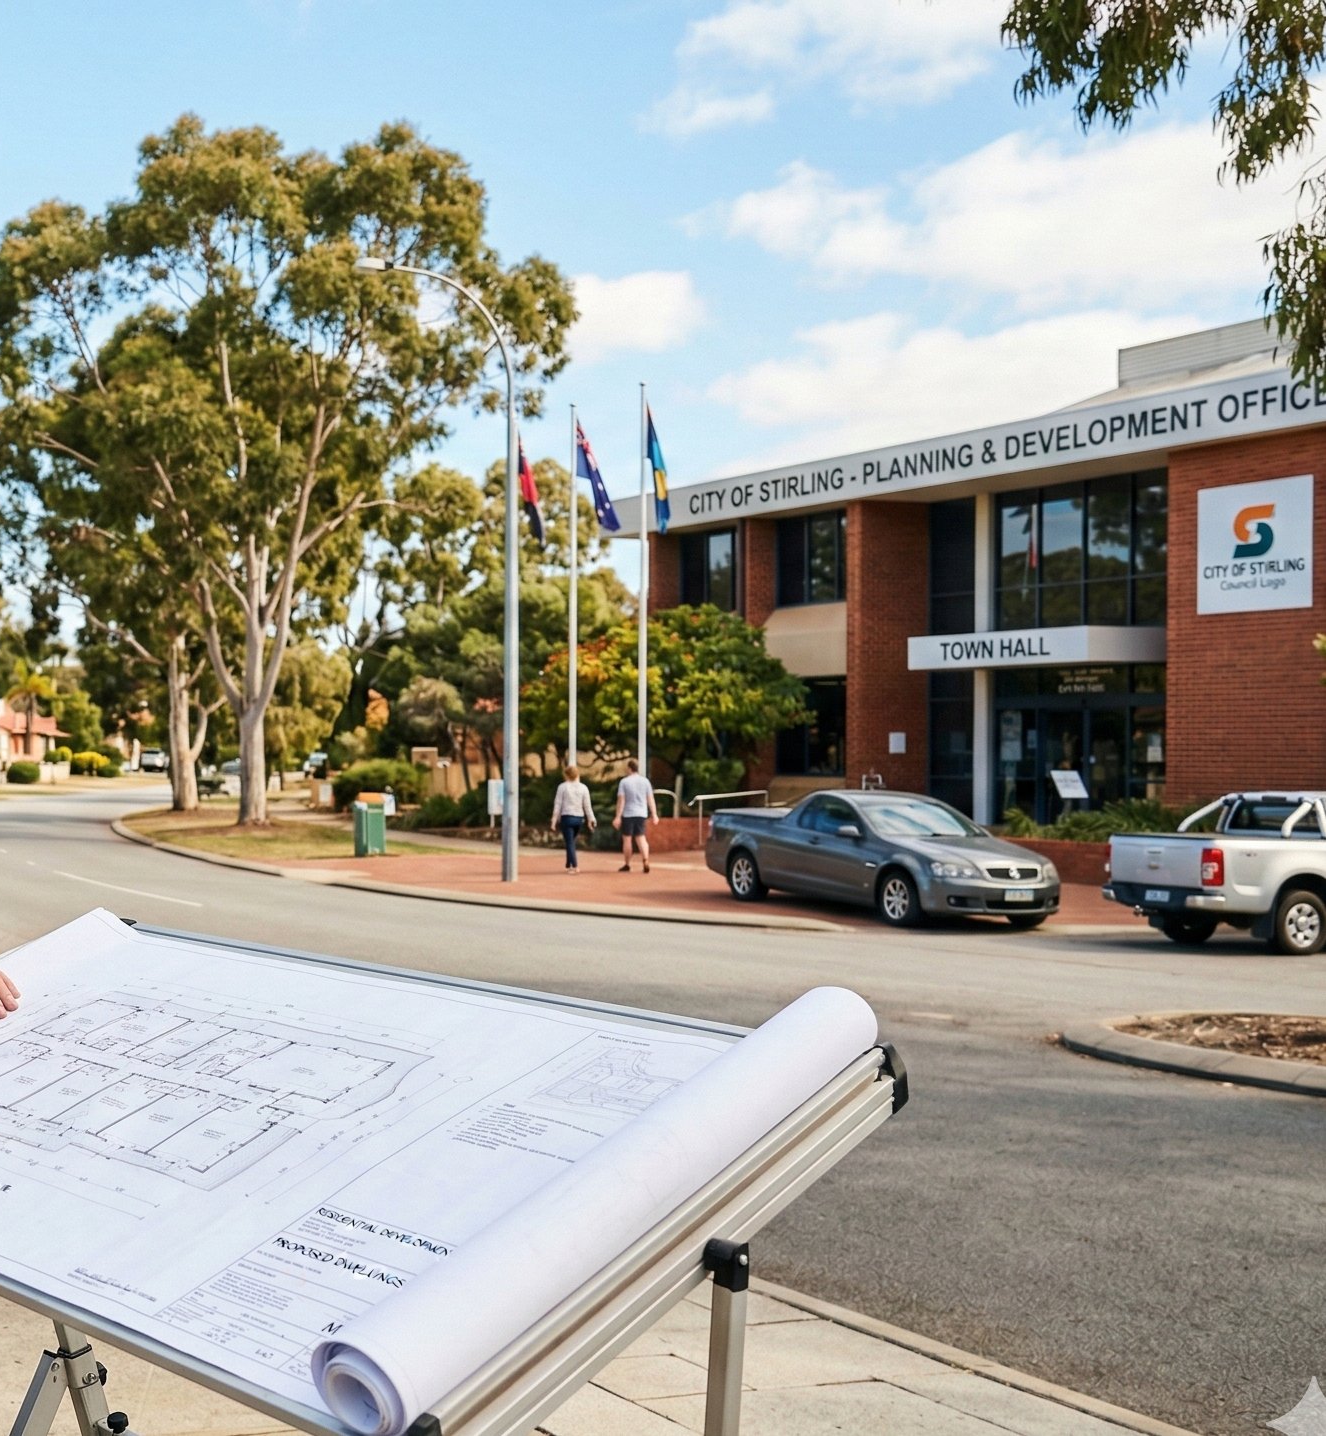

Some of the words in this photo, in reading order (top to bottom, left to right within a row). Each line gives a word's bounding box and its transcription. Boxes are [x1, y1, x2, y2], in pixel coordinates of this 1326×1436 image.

[689, 488, 727, 516] CITY
[730, 483, 755, 508] OF
[759, 467, 844, 503] STIRLING
[863, 443, 974, 485] PLANNING
[981, 439, 997, 464] &
[1005, 400, 1208, 461] DEVELOPMENT
[1203, 565, 1230, 580] CITY
[1231, 562, 1247, 577] OF
[940, 639, 993, 661] TOWN
[1000, 636, 1051, 658] HALL
